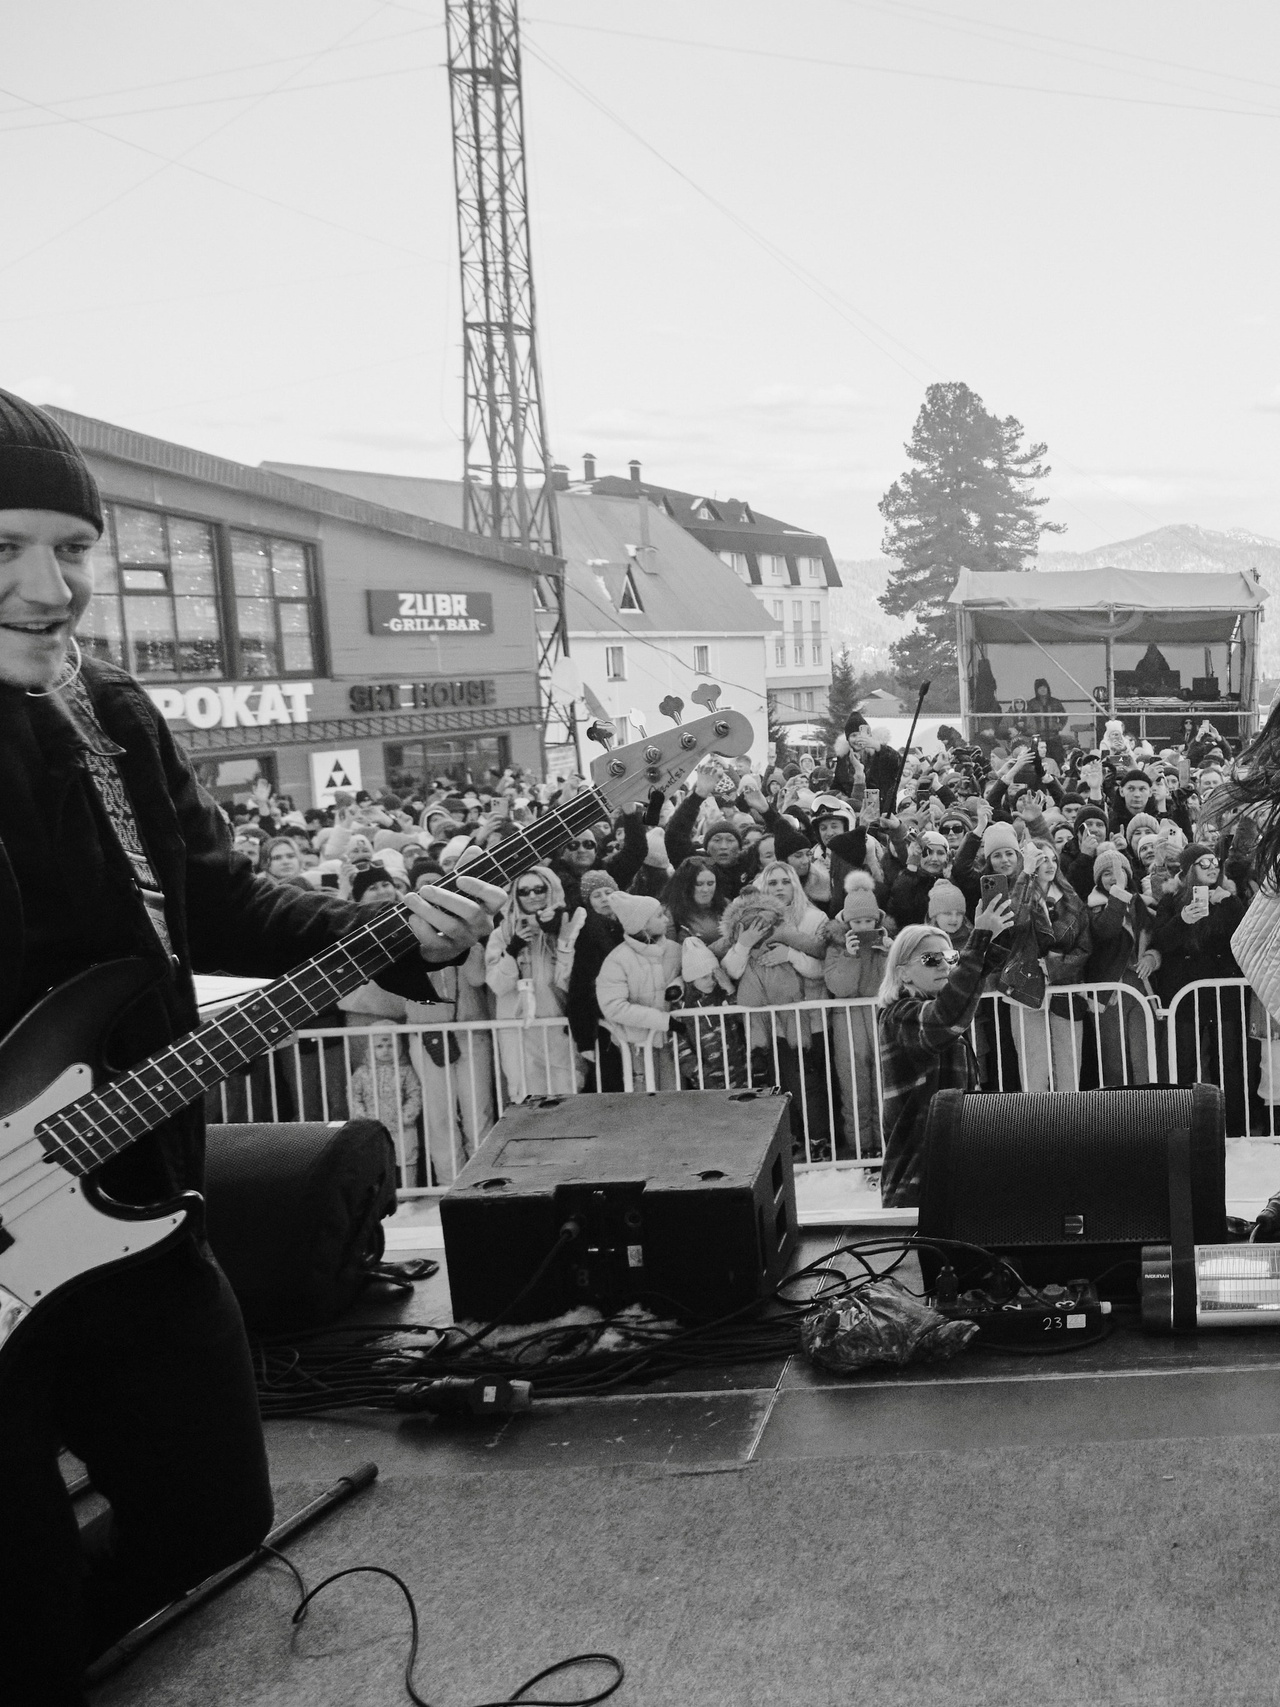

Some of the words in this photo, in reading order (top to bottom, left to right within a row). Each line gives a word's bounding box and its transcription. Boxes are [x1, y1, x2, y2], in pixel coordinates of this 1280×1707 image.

[398, 593, 469, 616] ZUBR
[349, 684, 401, 713] SKI
[412, 680, 497, 709] HOUSE
[1042, 1316, 1063, 1331] 23
